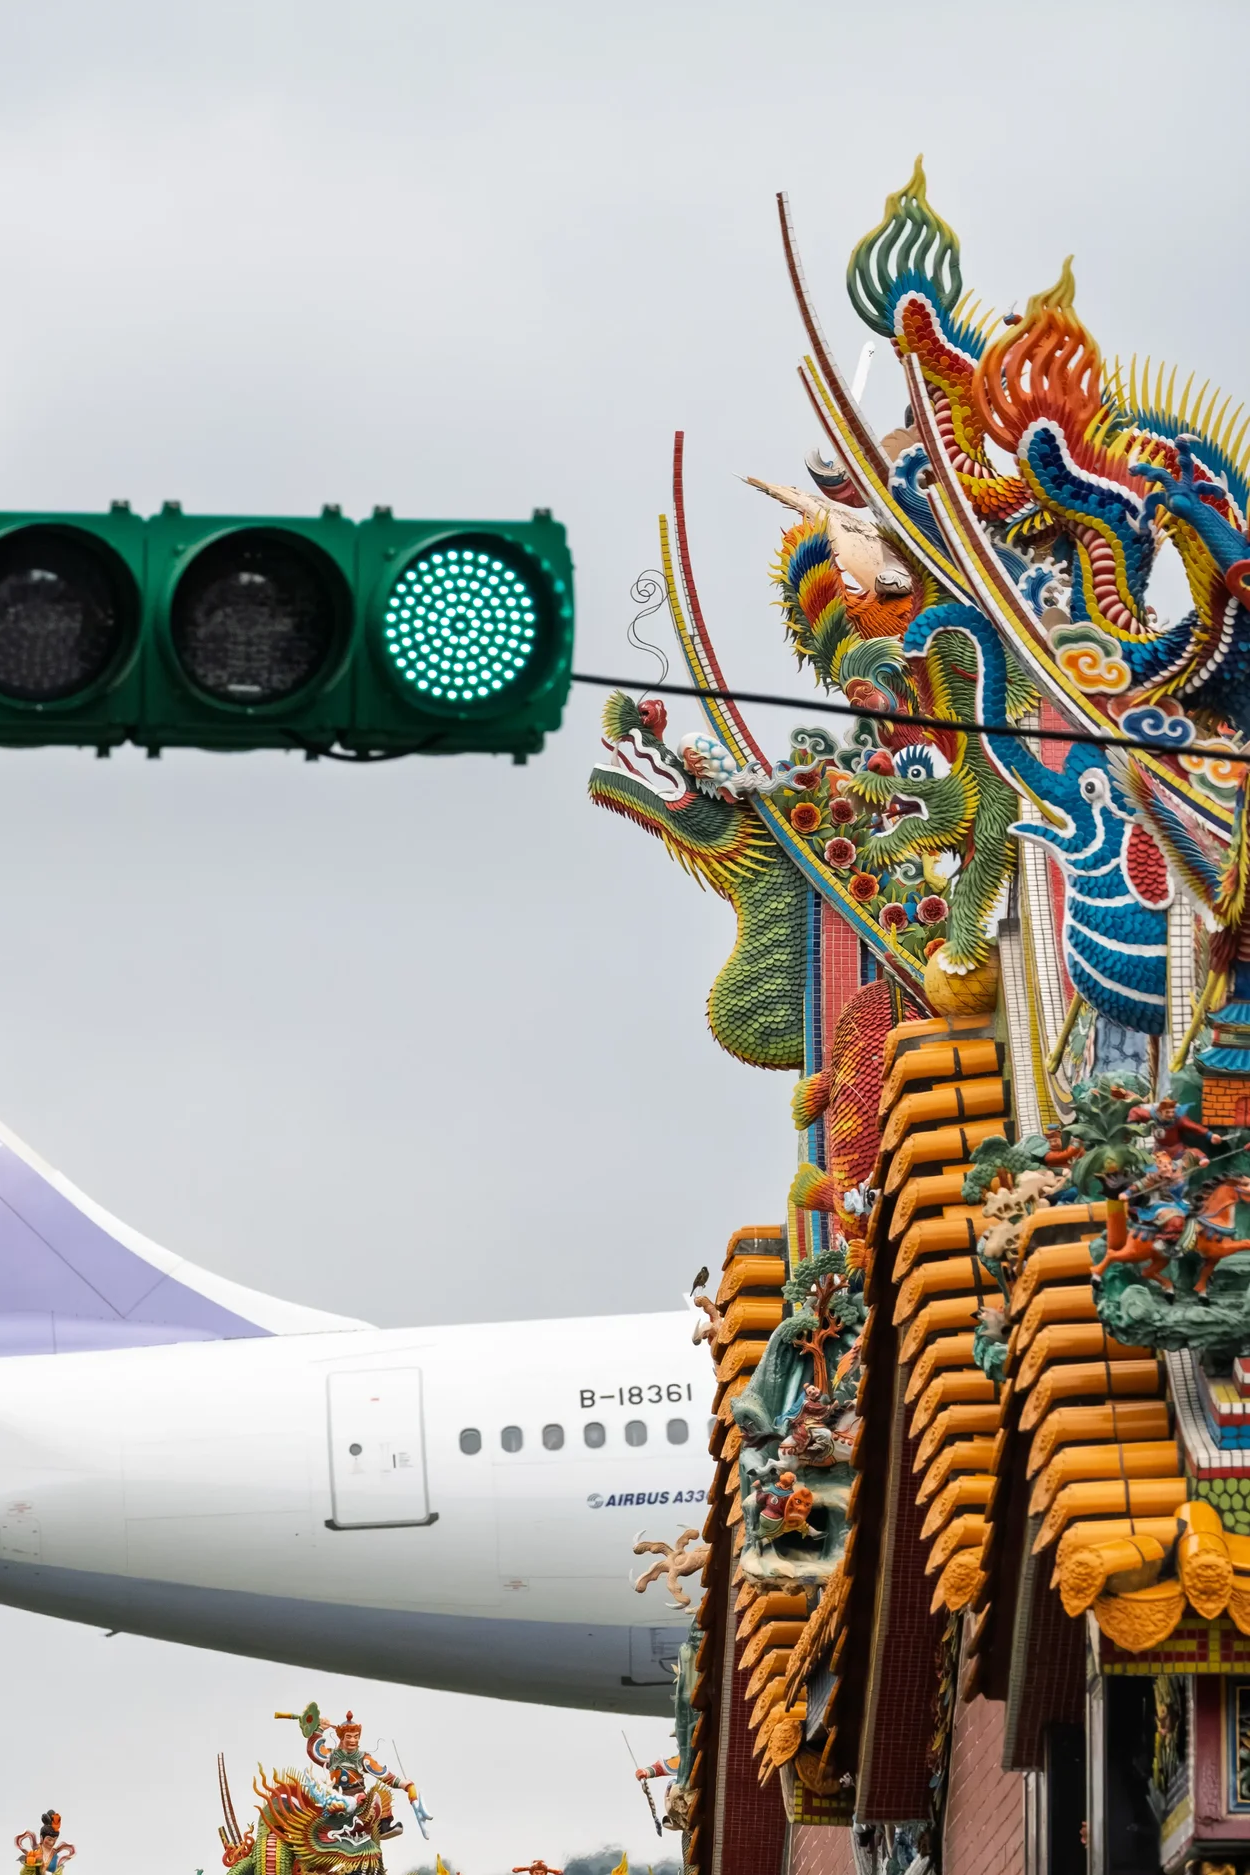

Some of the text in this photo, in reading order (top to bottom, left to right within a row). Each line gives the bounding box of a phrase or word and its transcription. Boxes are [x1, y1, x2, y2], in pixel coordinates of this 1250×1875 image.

[579, 1382, 693, 1409] B-18361
[605, 1489, 710, 1507] AIRBUS A33
